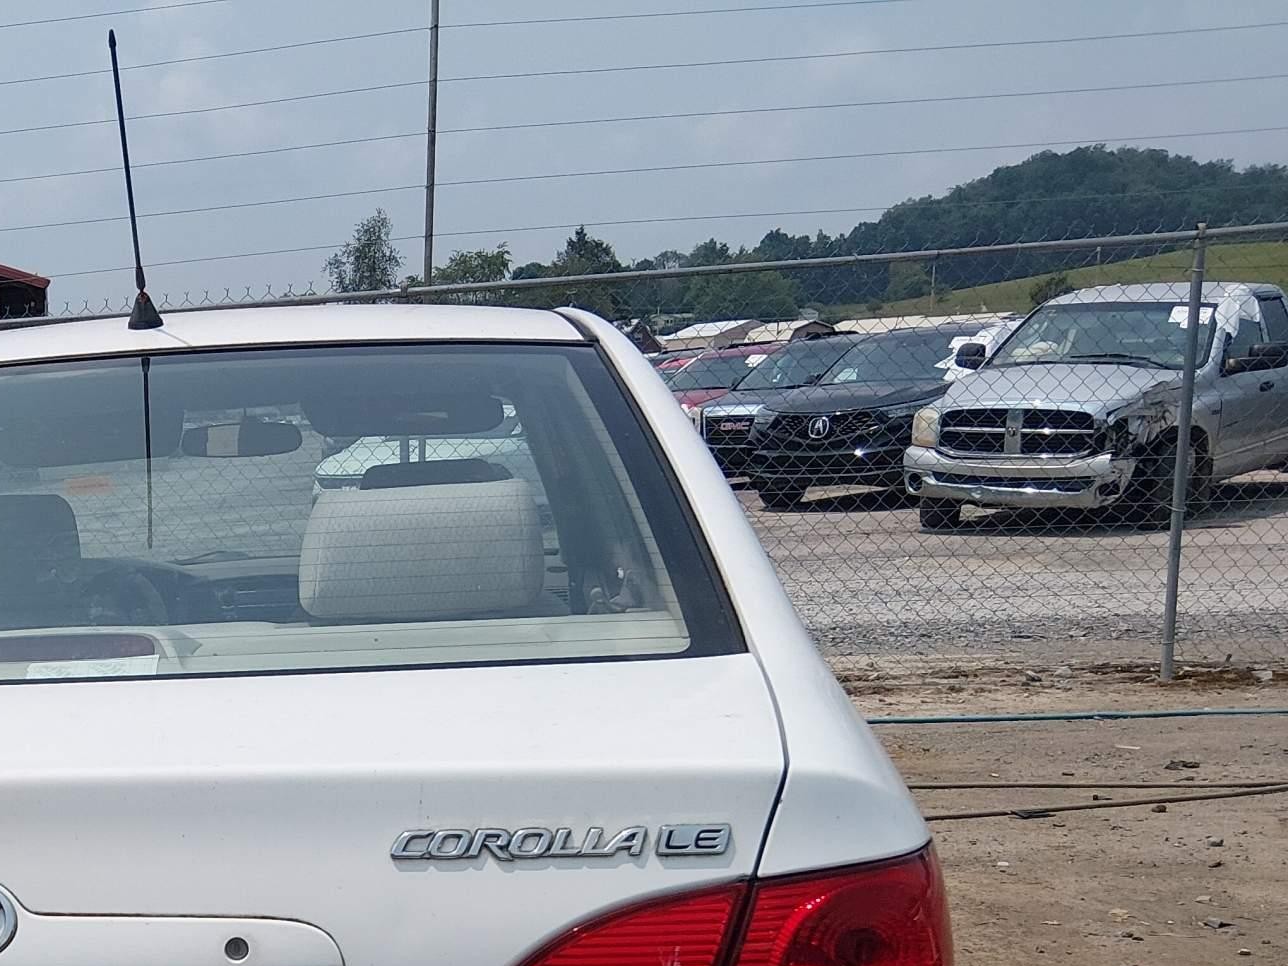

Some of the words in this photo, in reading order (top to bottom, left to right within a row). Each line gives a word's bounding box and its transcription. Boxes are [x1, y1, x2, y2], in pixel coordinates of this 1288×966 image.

[720, 422, 750, 431] GMC
[391, 826, 648, 861] COROLLA
[661, 827, 728, 853] LE
